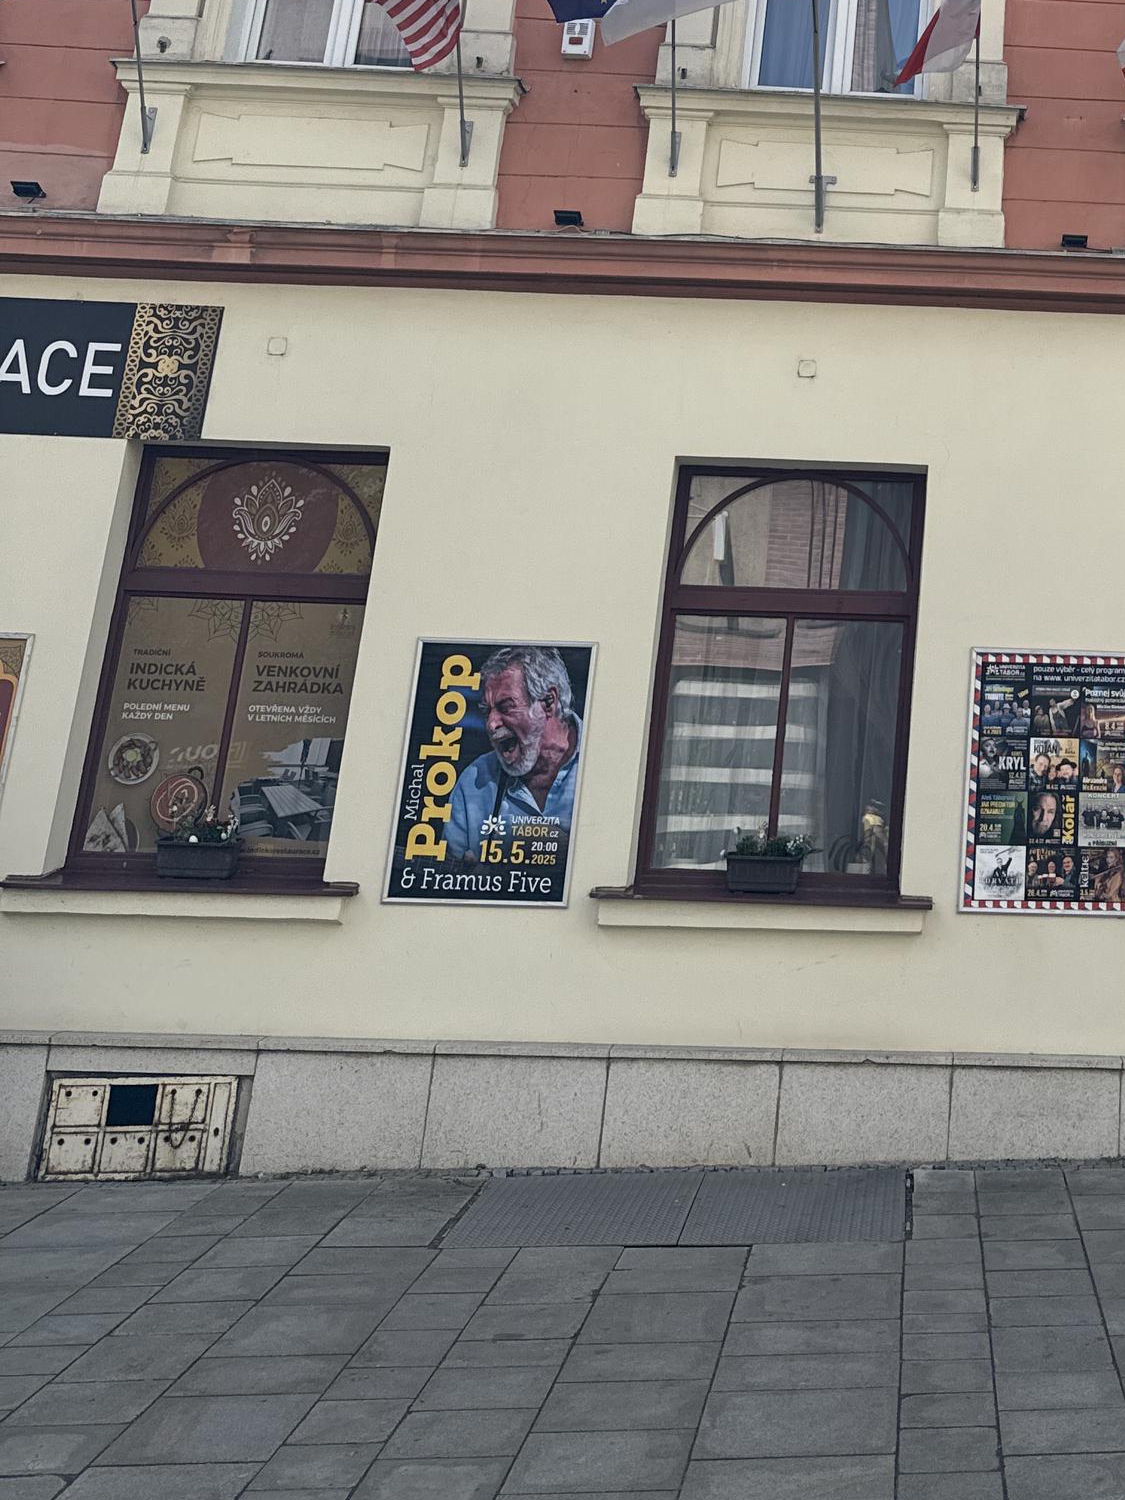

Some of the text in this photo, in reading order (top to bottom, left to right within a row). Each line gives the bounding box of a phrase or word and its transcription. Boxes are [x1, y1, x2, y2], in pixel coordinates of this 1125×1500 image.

[129, 661, 197, 676] INDICKÁ
[255, 664, 341, 679] VENKOVNÍ
[1056, 665, 1075, 675] výběr
[1080, 666, 1094, 674] celý
[1096, 667, 1125, 675] program
[126, 676, 206, 692] KUCHYNĚ
[252, 679, 344, 695] ZAHRÁDKA
[1085, 688, 1125, 698] Poznej svůj
[123, 702, 190, 712] POLEDNÍ MENU
[248, 704, 322, 714] OTEVŘENA VŽDY
[154, 712, 173, 721] DEN
[247, 714, 253, 722] V
[255, 713, 292, 723] LETNÍCH
[404, 654, 481, 862] Prokop
[998, 756, 1027, 770] KRYL
[404, 763, 425, 821] Michal
[511, 815, 560, 825] UNIVERZITA
[1061, 794, 1075, 840] Kolář
[531, 841, 558, 852] 20:00
[530, 854, 557, 865] 2025
[400, 867, 552, 894] & Framus Five
